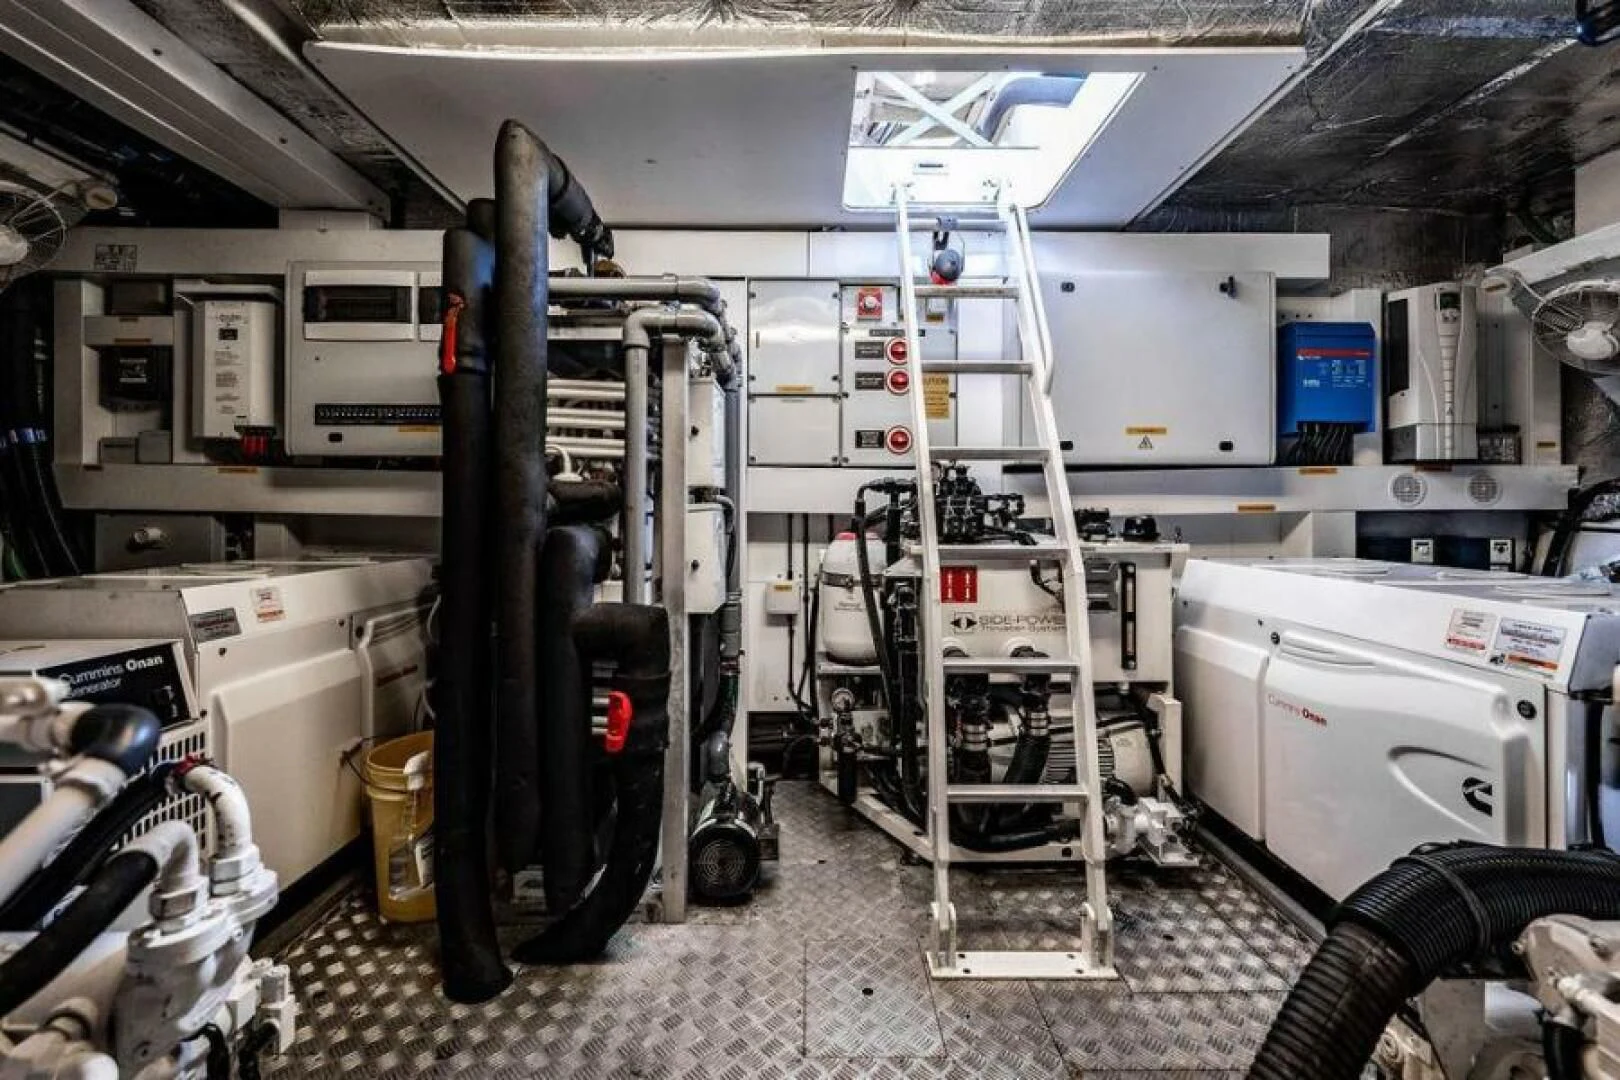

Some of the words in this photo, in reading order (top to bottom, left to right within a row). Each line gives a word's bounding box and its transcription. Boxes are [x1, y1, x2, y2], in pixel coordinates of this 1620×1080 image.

[979, 615, 1066, 625] SIDE-POWE
[126, 655, 163, 672] Onan
[70, 678, 121, 698] enerator
